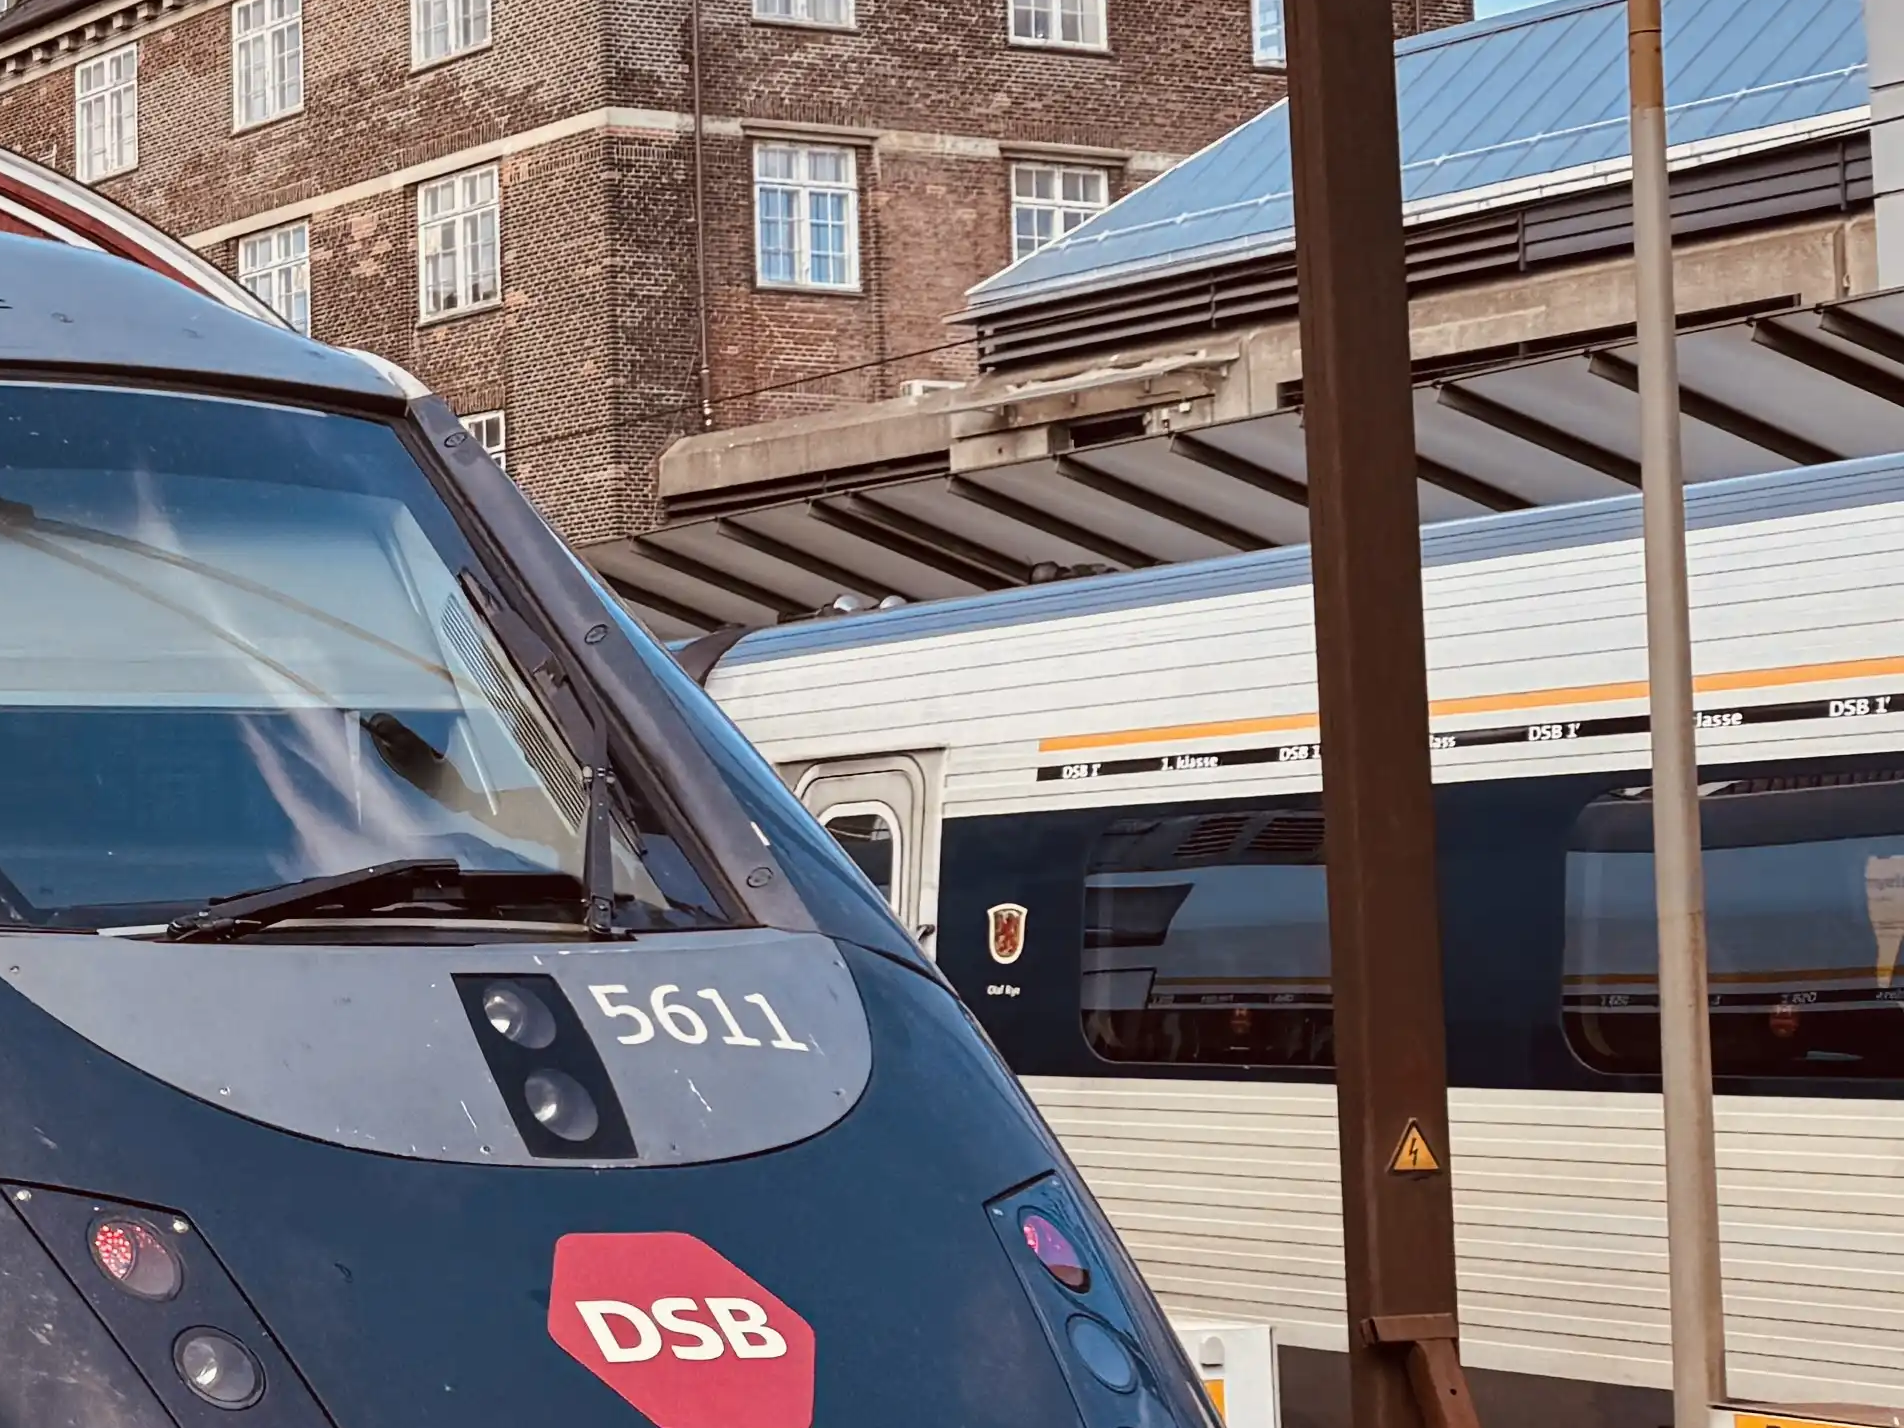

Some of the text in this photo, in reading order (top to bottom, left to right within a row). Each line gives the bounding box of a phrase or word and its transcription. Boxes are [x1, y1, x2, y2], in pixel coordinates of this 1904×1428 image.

[1828, 698, 1870, 717] DSB
[1694, 711, 1743, 728] lasse
[1528, 725, 1563, 741] DSB
[1429, 735, 1456, 749] lass
[1176, 754, 1219, 770] klasse
[1279, 746, 1310, 762] DSB
[1062, 764, 1089, 780] DSB
[587, 983, 810, 1053] 5611
[574, 1296, 788, 1363] DSB
